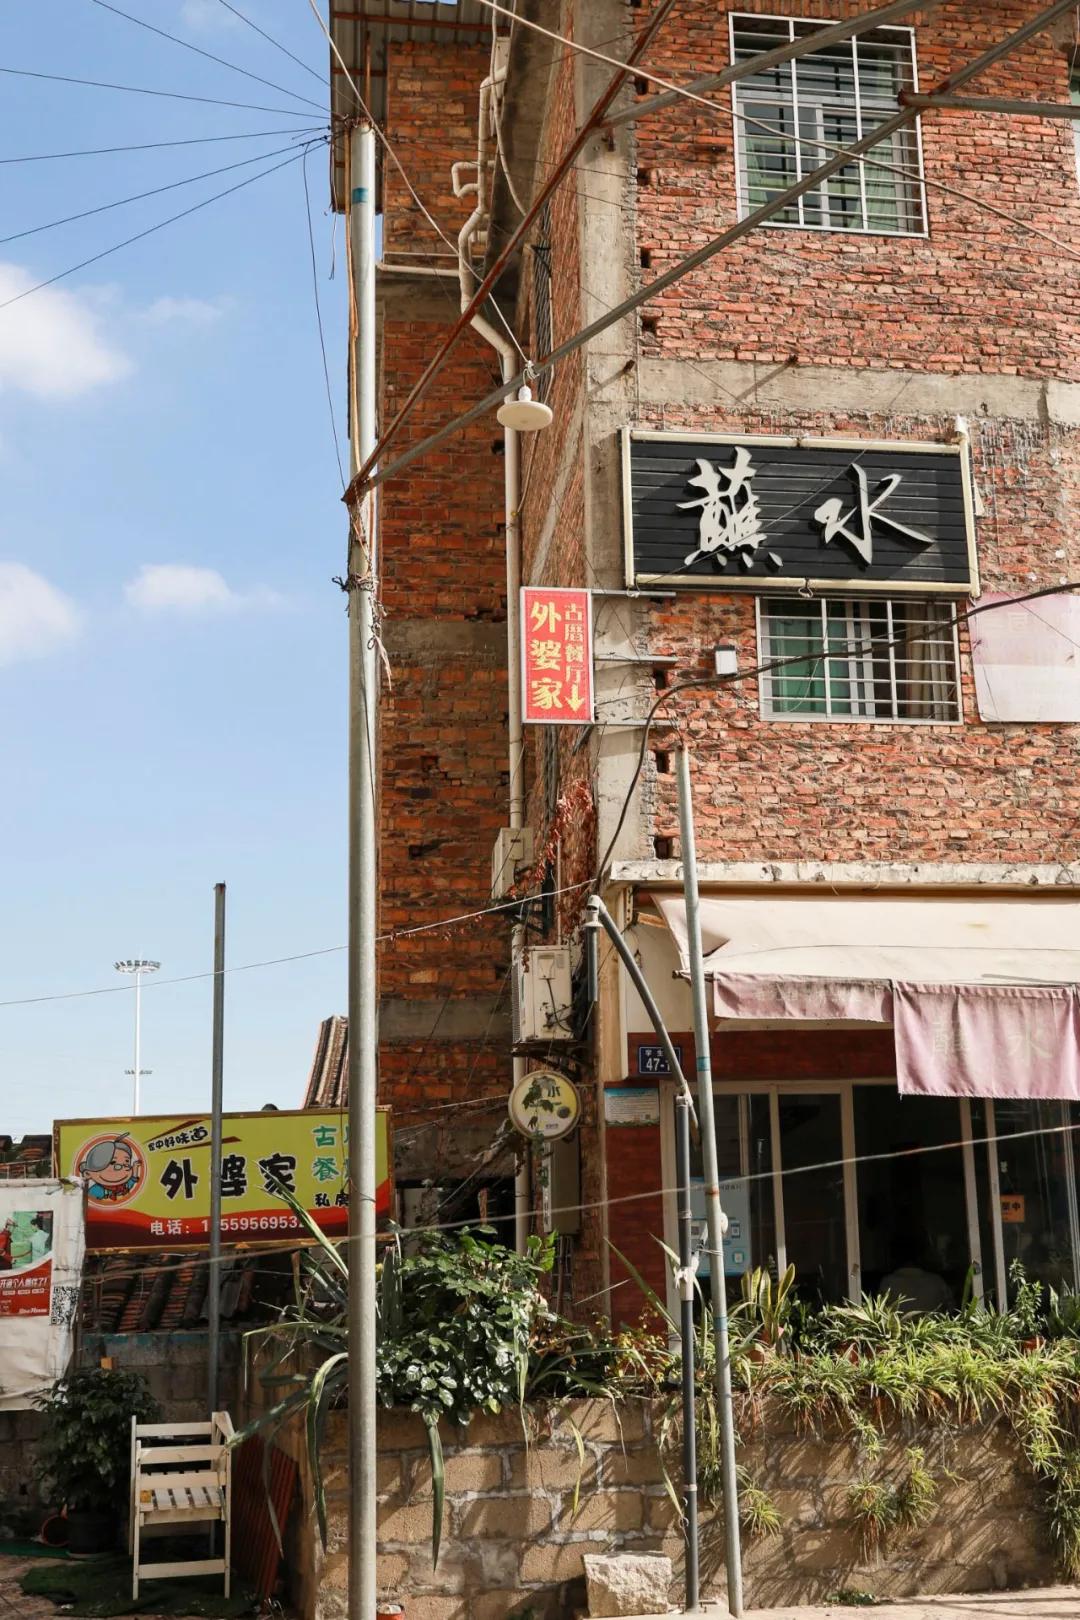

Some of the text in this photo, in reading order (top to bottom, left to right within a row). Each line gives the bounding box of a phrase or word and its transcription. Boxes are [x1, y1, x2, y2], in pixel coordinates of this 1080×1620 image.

[529, 600, 564, 709] 外婆家
[159, 1152, 298, 1200] 外婆家
[201, 1215, 305, 1233] 155956953
